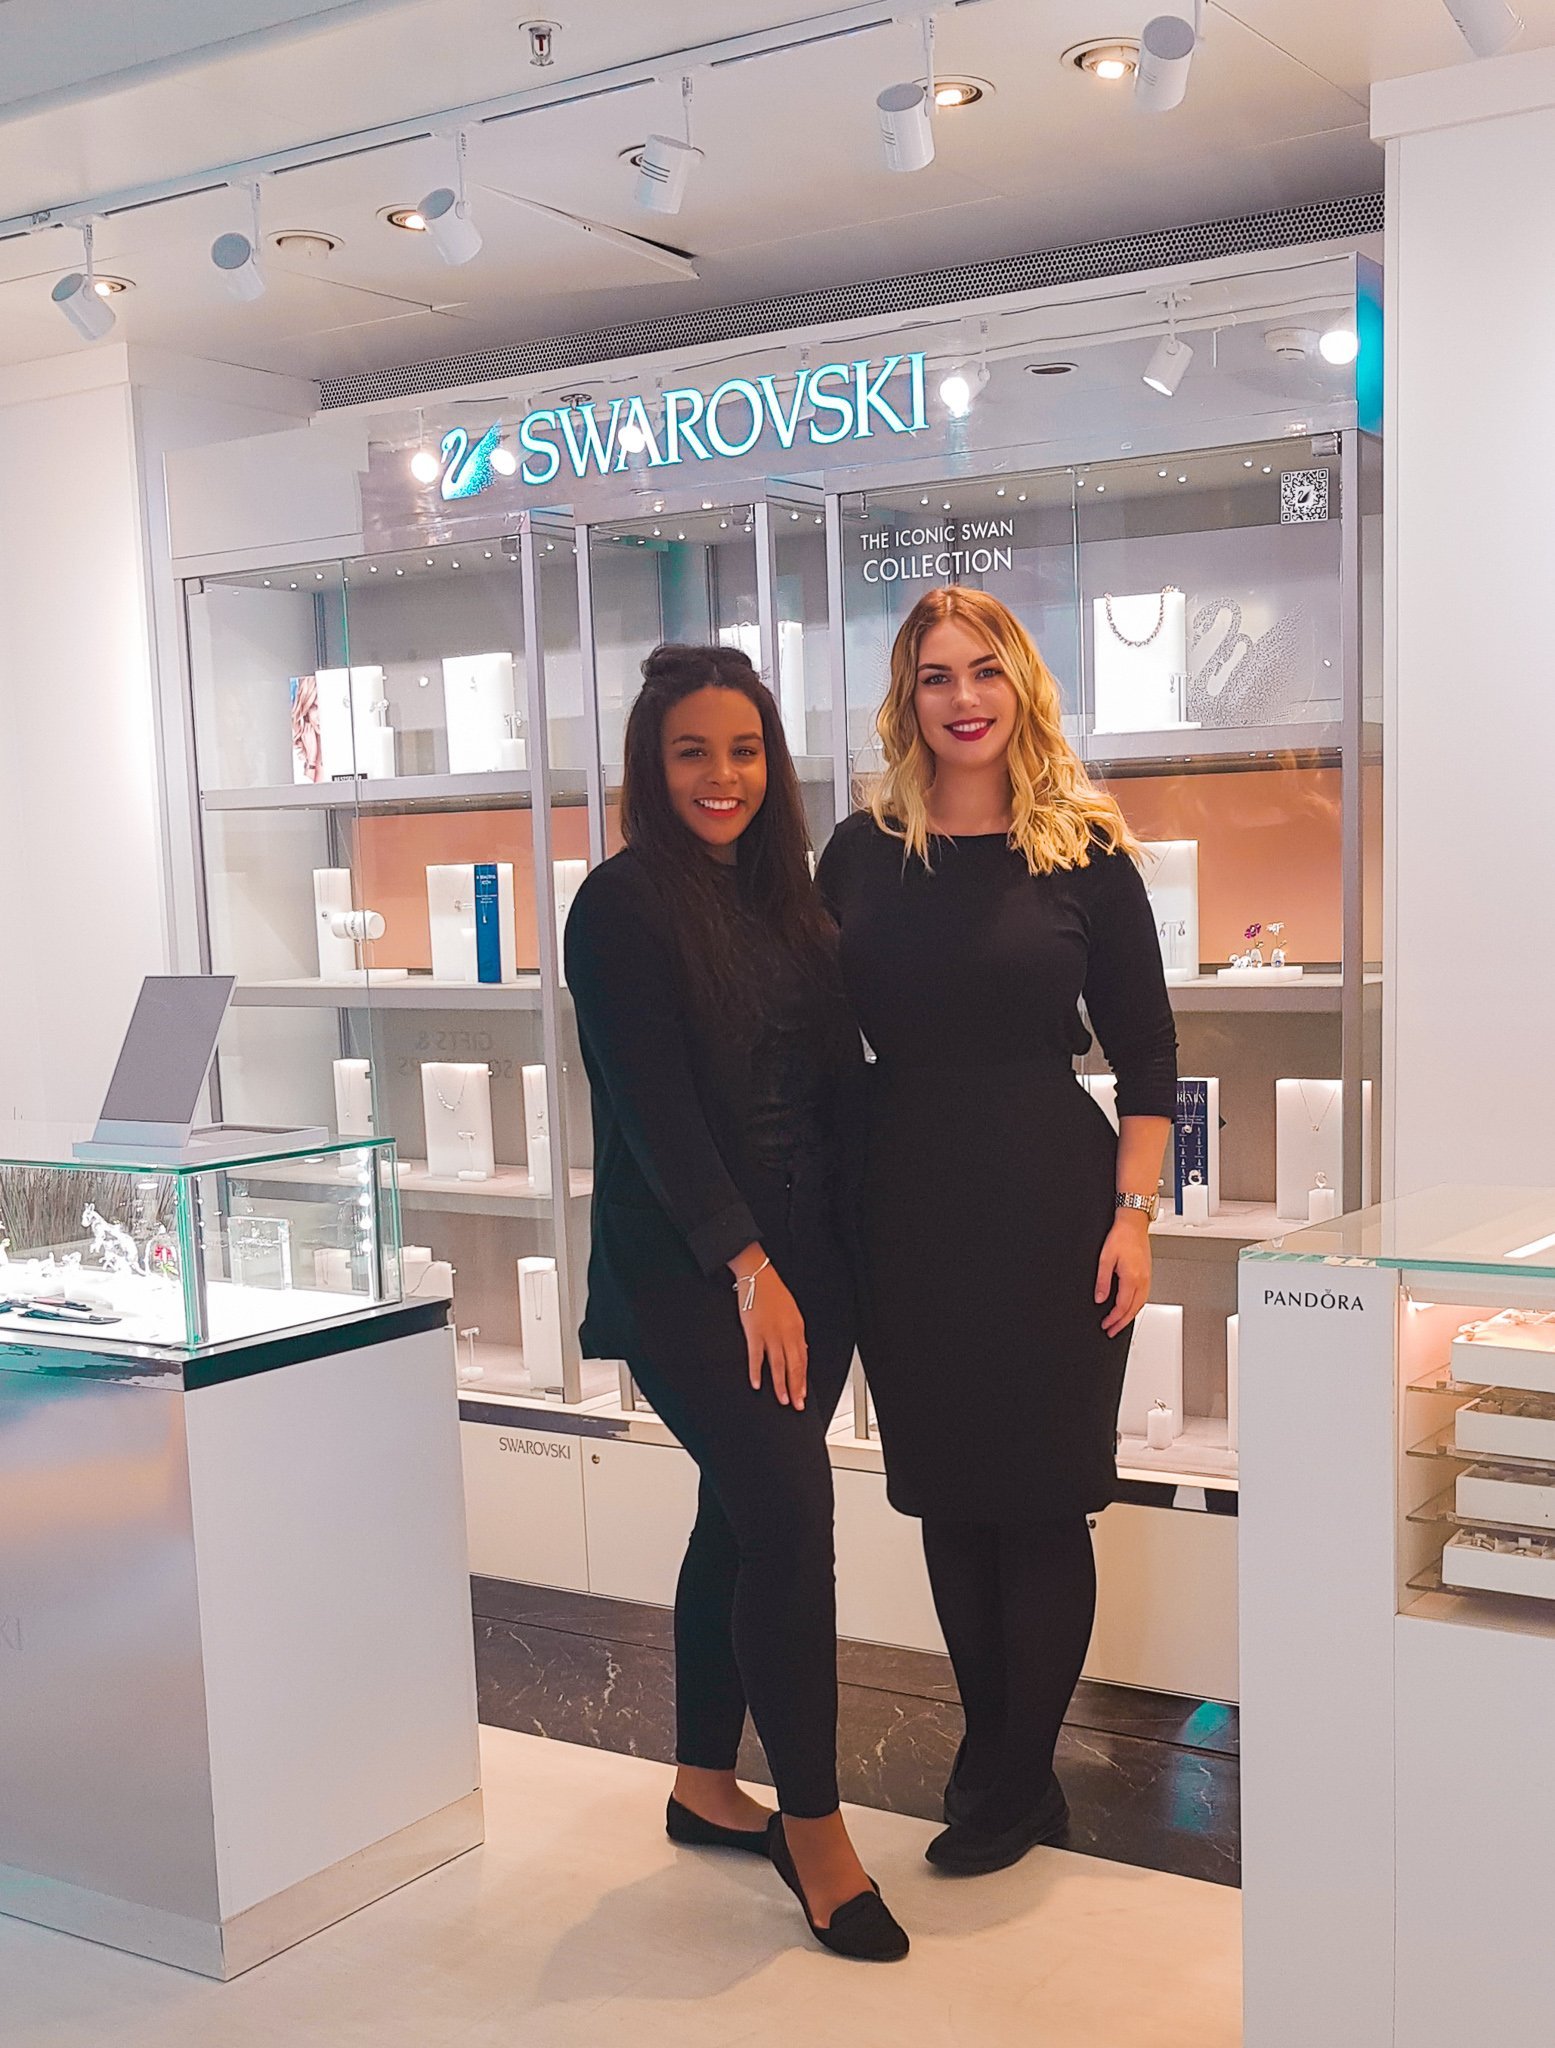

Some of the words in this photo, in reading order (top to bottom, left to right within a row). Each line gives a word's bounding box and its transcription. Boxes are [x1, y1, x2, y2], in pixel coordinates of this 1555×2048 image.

[521, 351, 930, 486] SWAROVSKI
[860, 532, 889, 551] THE
[896, 525, 956, 547] ICONIC
[961, 519, 1014, 541] SWAN
[863, 546, 1012, 583] COLLECTION
[1264, 1289, 1364, 1311] PANDORA
[499, 1436, 571, 1460] SWAROVSKI
